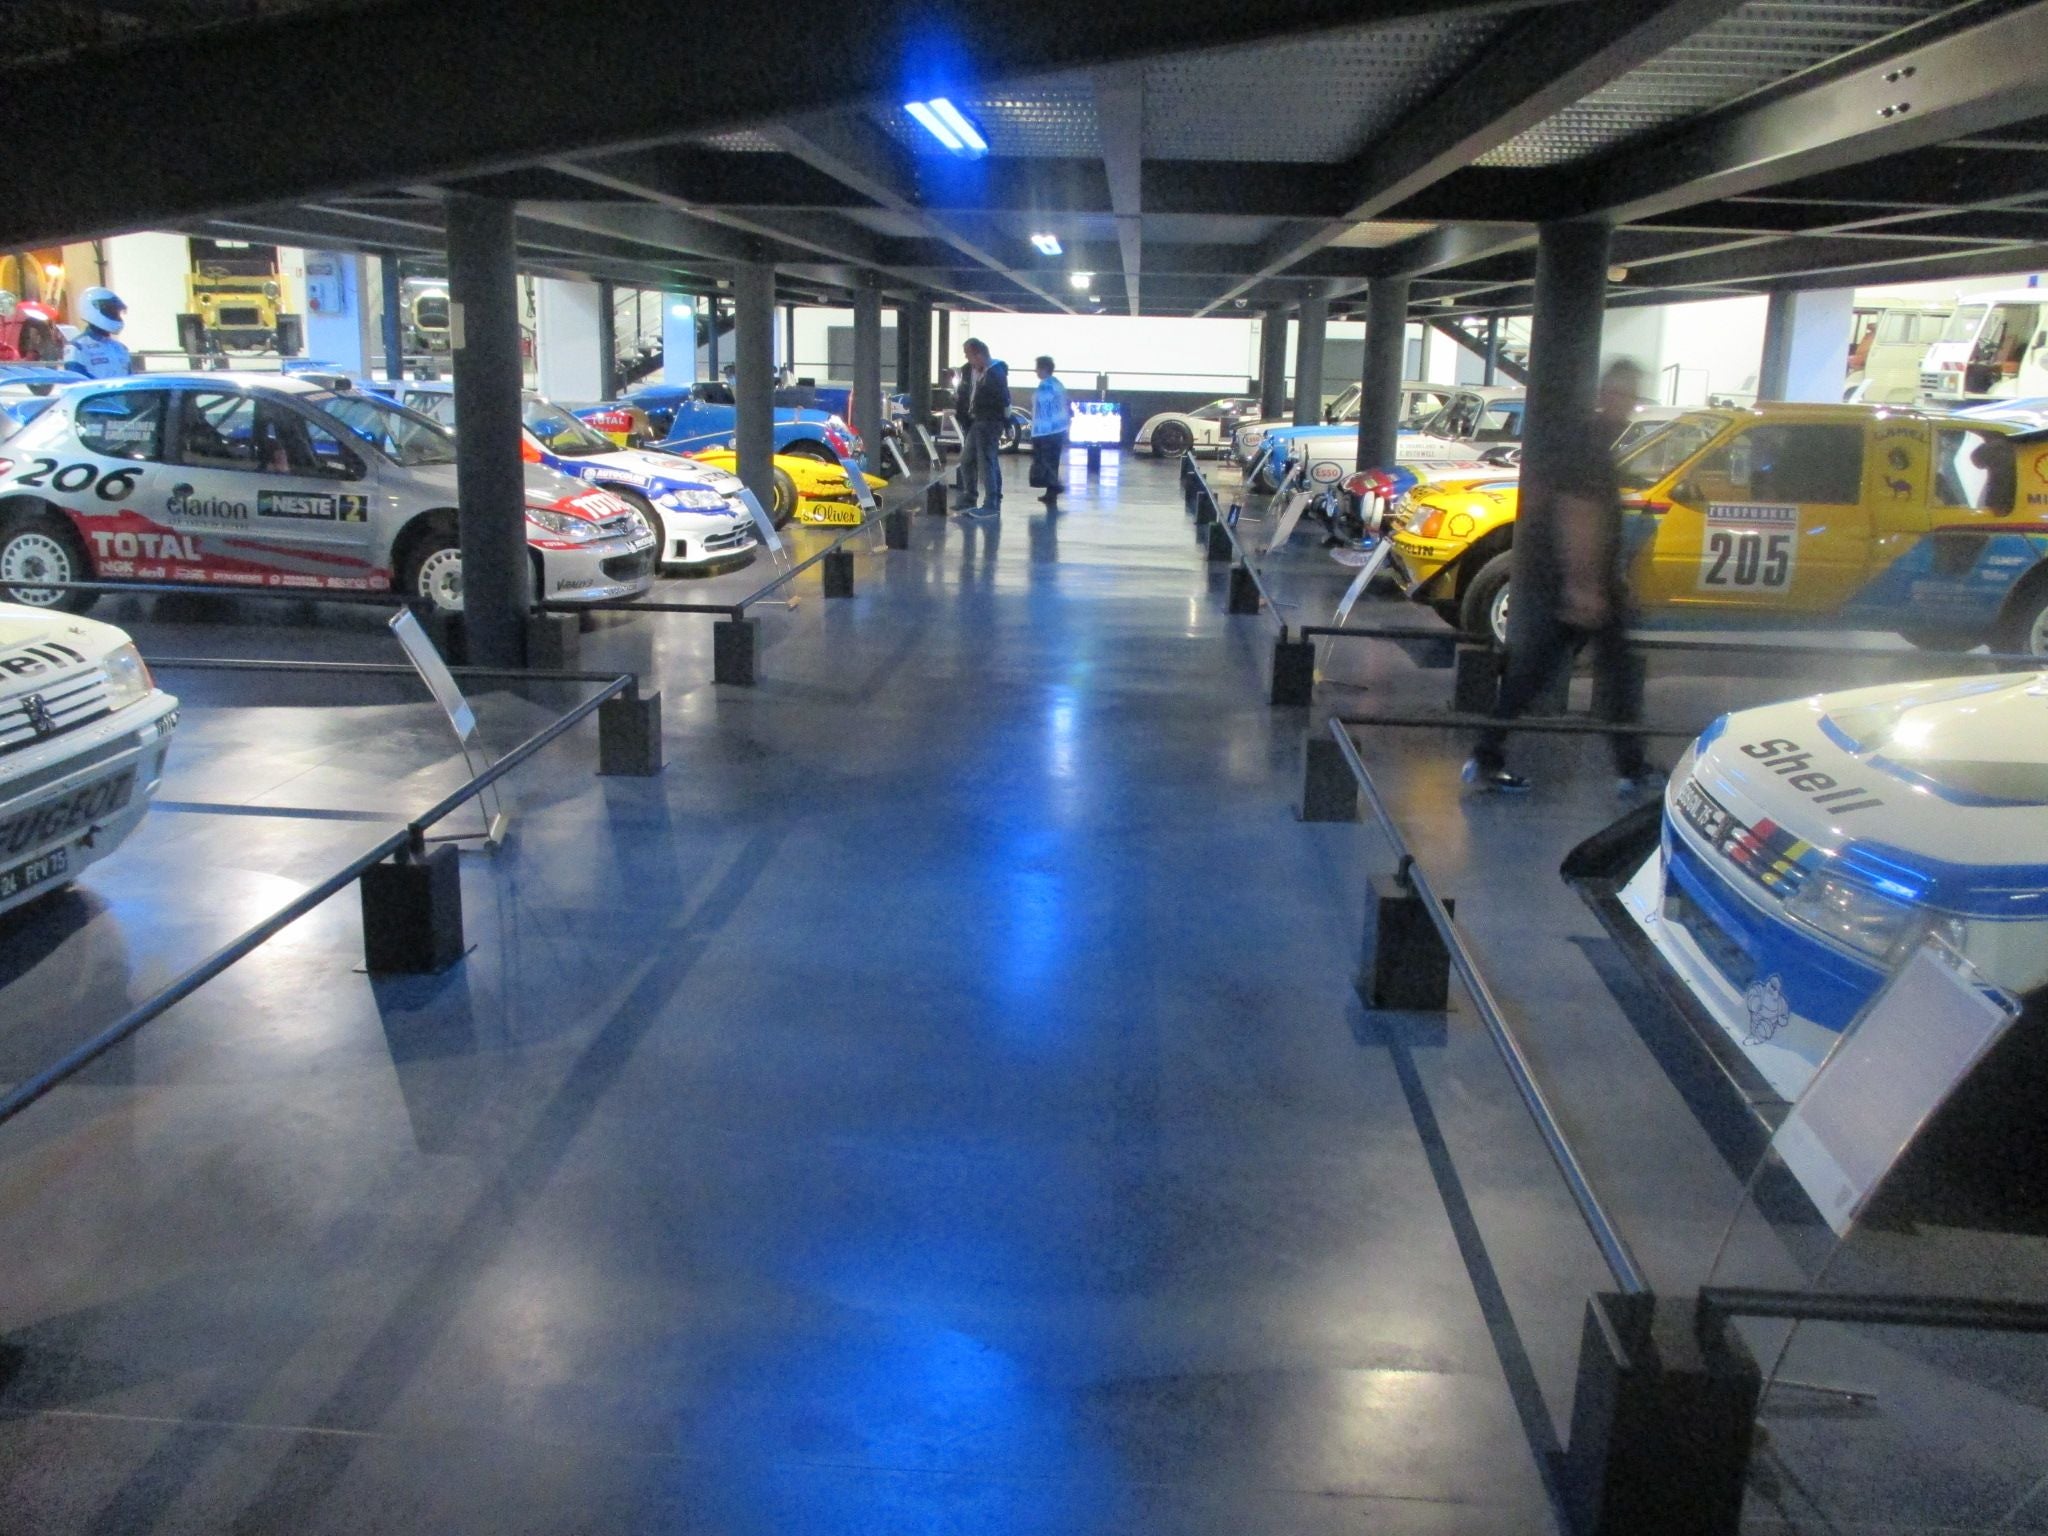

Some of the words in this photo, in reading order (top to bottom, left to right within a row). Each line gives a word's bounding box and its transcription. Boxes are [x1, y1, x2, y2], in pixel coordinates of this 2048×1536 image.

[592, 416, 625, 425] TOTAL
[14, 458, 144, 501] 206
[271, 494, 332, 516] NESTE
[347, 495, 361, 522] 2
[92, 531, 202, 561] TOTAL
[1705, 533, 1791, 587] 205
[99, 560, 134, 573] NGK
[1740, 739, 1884, 815] Shell
